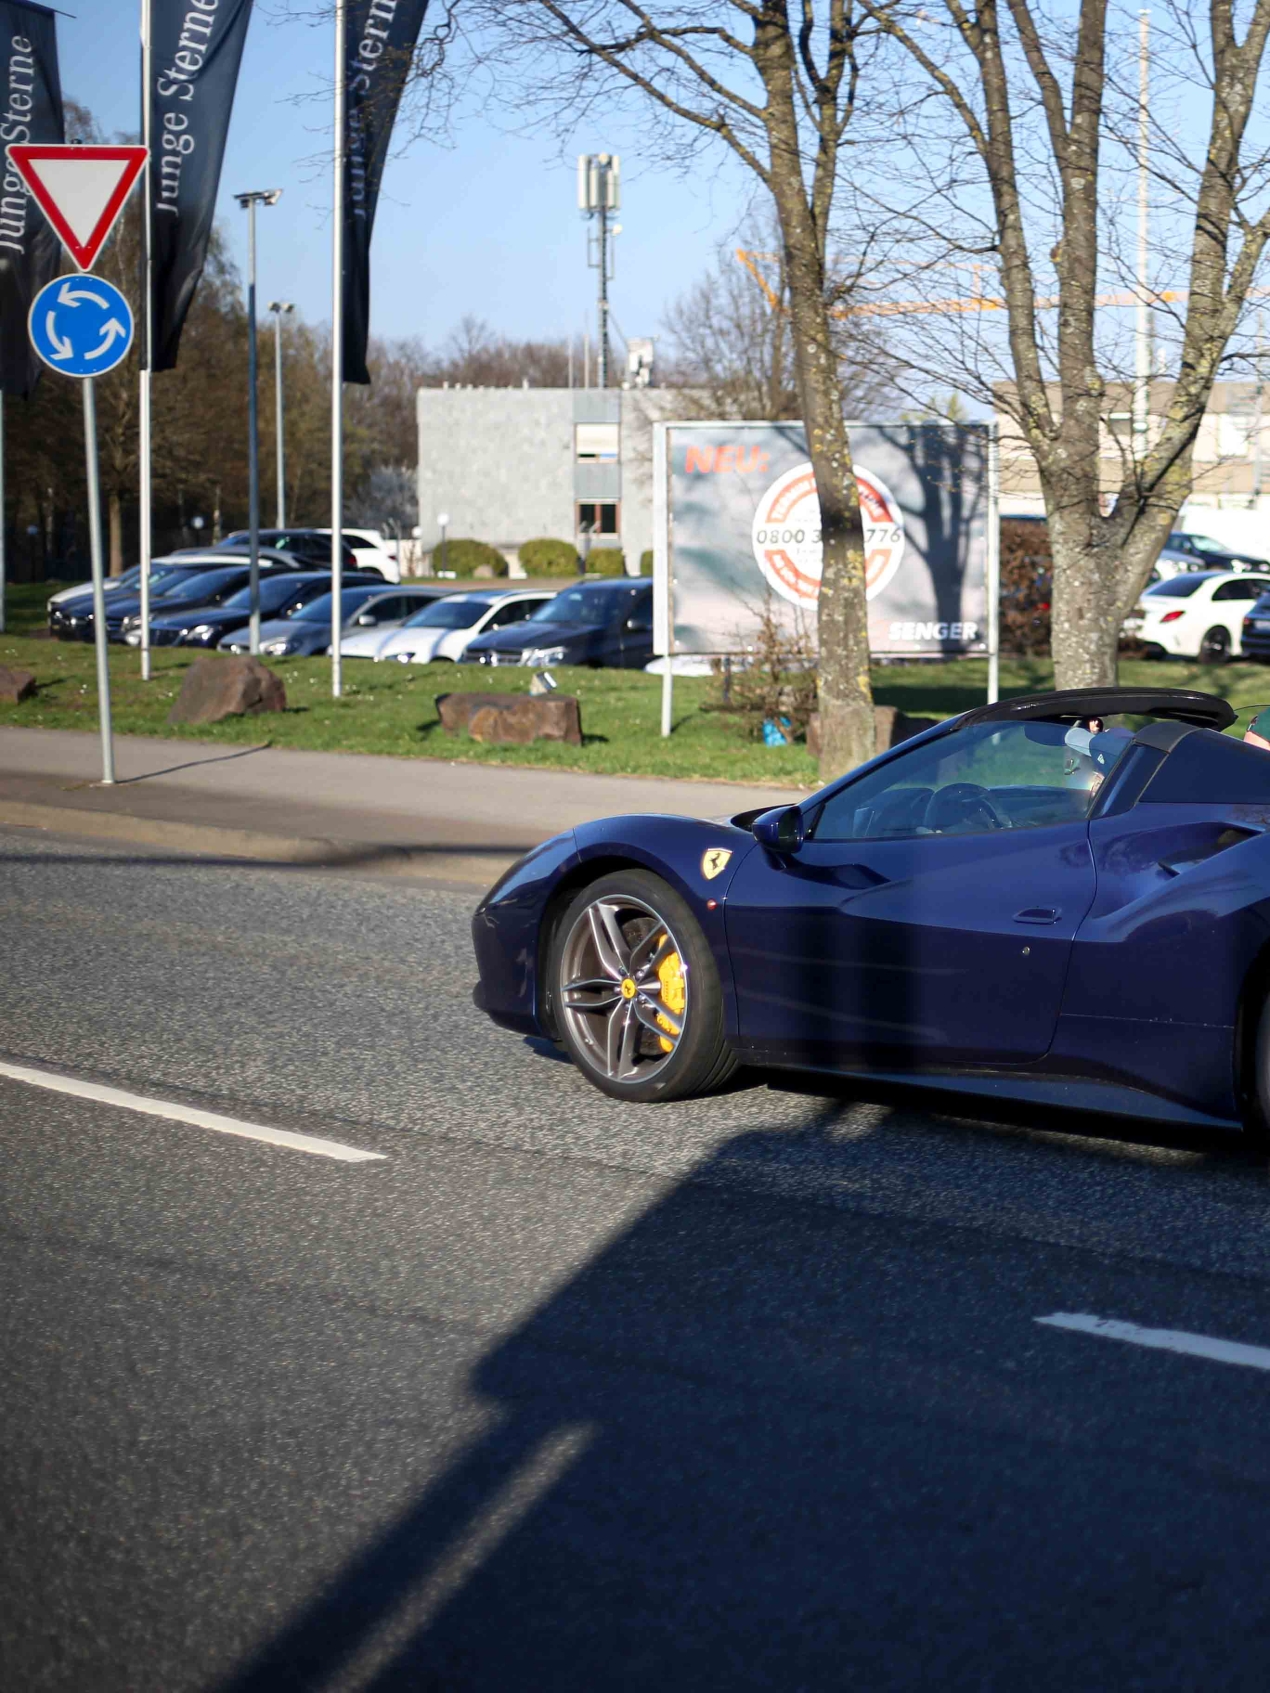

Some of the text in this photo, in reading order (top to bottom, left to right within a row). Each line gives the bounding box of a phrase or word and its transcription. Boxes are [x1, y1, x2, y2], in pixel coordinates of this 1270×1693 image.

[0, 35, 34, 144] Sterne
[156, 112, 195, 217] Junge
[685, 445, 770, 474] NEU:
[756, 529, 806, 544] 0800
[888, 621, 979, 641] SENGER
